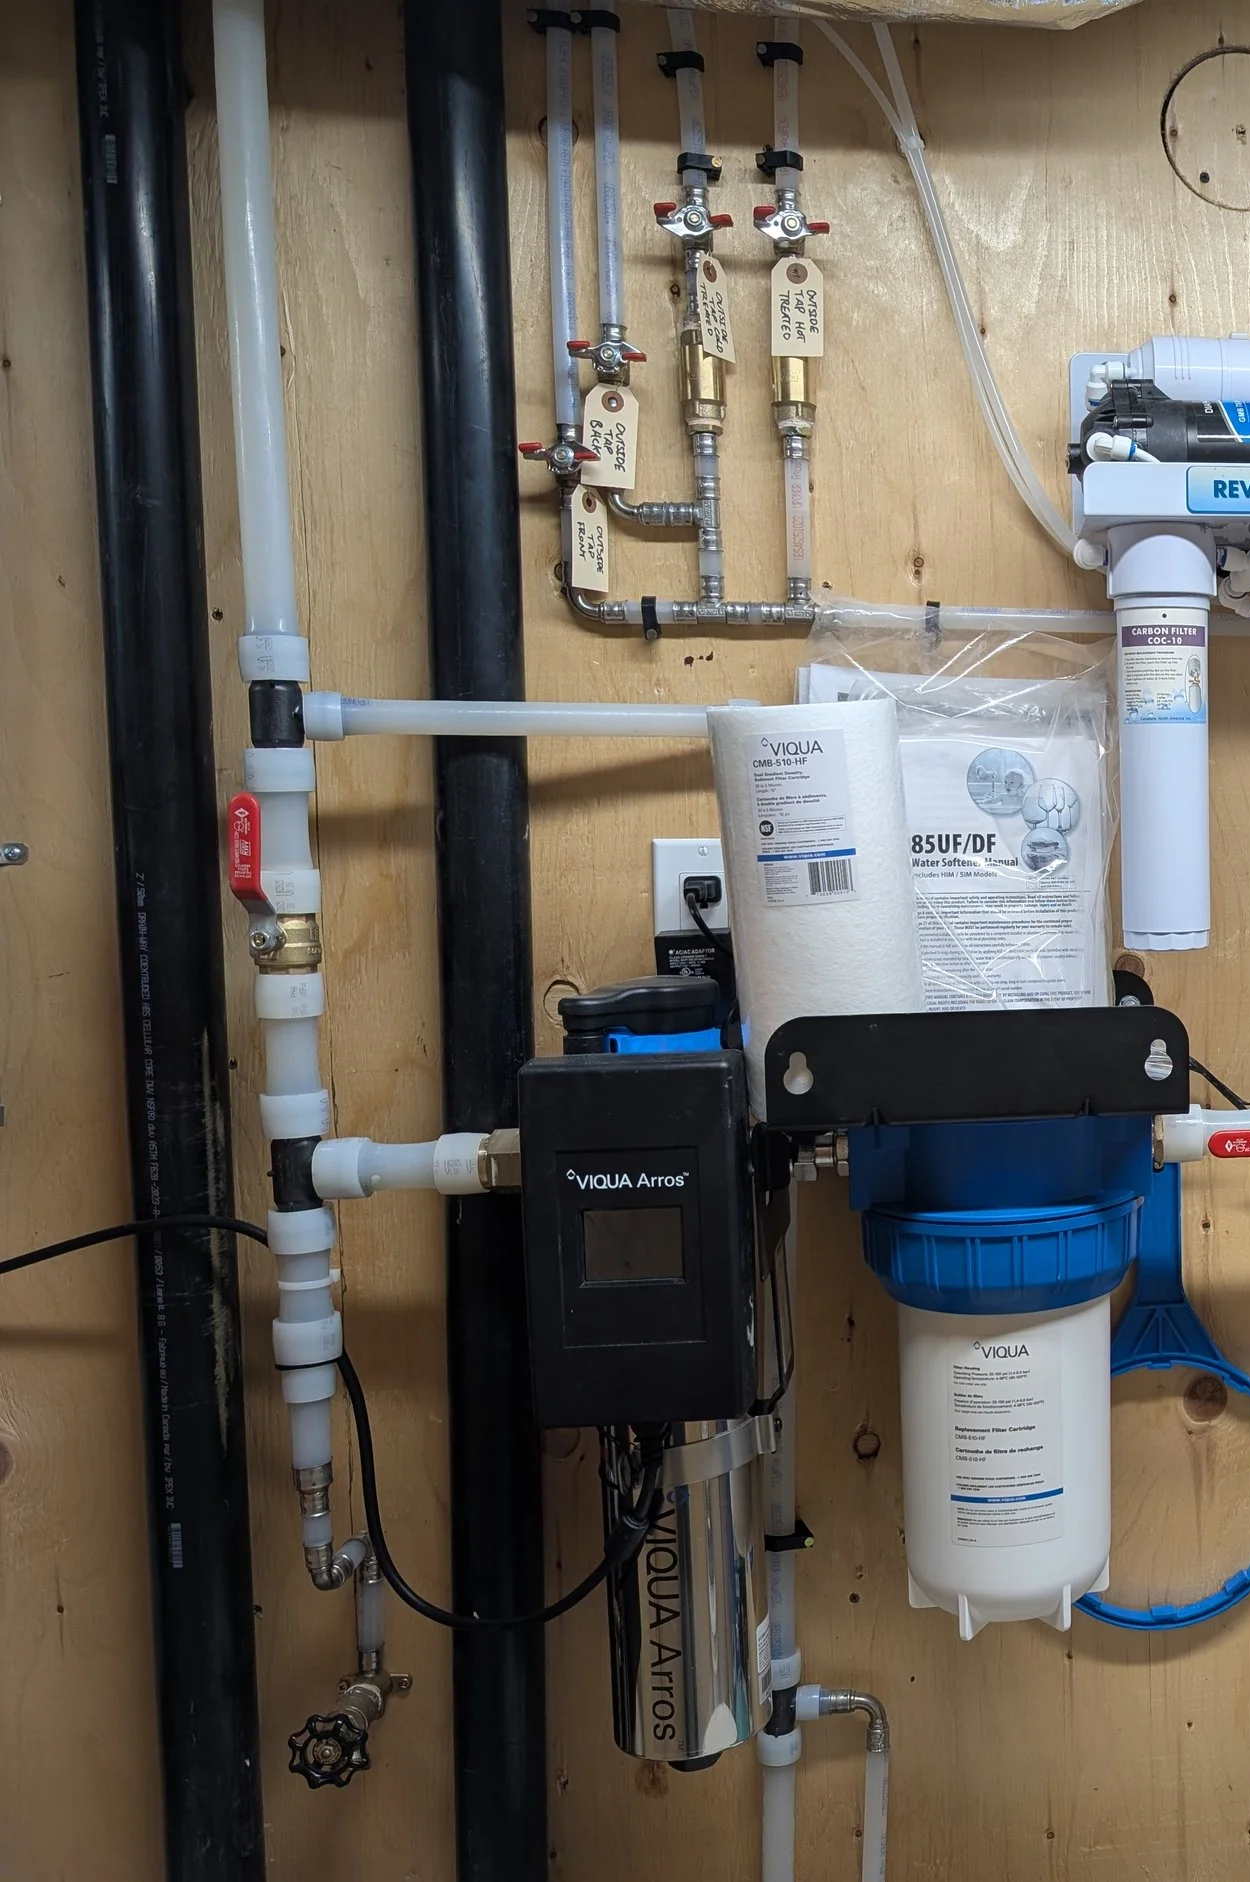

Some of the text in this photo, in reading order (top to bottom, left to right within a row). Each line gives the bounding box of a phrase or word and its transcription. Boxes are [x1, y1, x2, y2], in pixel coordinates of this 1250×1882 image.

[700, 283, 713, 336] TREATED
[794, 289, 806, 314] TAP
[807, 289, 819, 335] OUTSIDE
[709, 297, 724, 354] TAP COLD
[715, 292, 729, 345] OUTSIDE
[779, 290, 792, 341] TREATED
[590, 419, 602, 457] BACK
[604, 429, 613, 457] TAP
[614, 422, 628, 473] OUTSIDE
[577, 521, 587, 562] FRONT
[588, 533, 596, 560] TAP
[596, 525, 604, 575] OUTSIDE
[1131, 627, 1197, 636] CARBON FILTER
[1147, 637, 1182, 645] COC-10
[770, 740, 824, 757] VIQUA
[753, 757, 808, 769] CMB-510-HF
[911, 833, 997, 854] 85UF/DF
[912, 858, 939, 868] Water
[974, 870, 998, 878] Models
[576, 1173, 633, 1190] VIQUA
[981, 1344, 1030, 1359] VIQUA
[955, 1425, 991, 1433] Replacement
[1018, 1445, 1044, 1453] rechange
[645, 1508, 682, 1630] VIQUA
